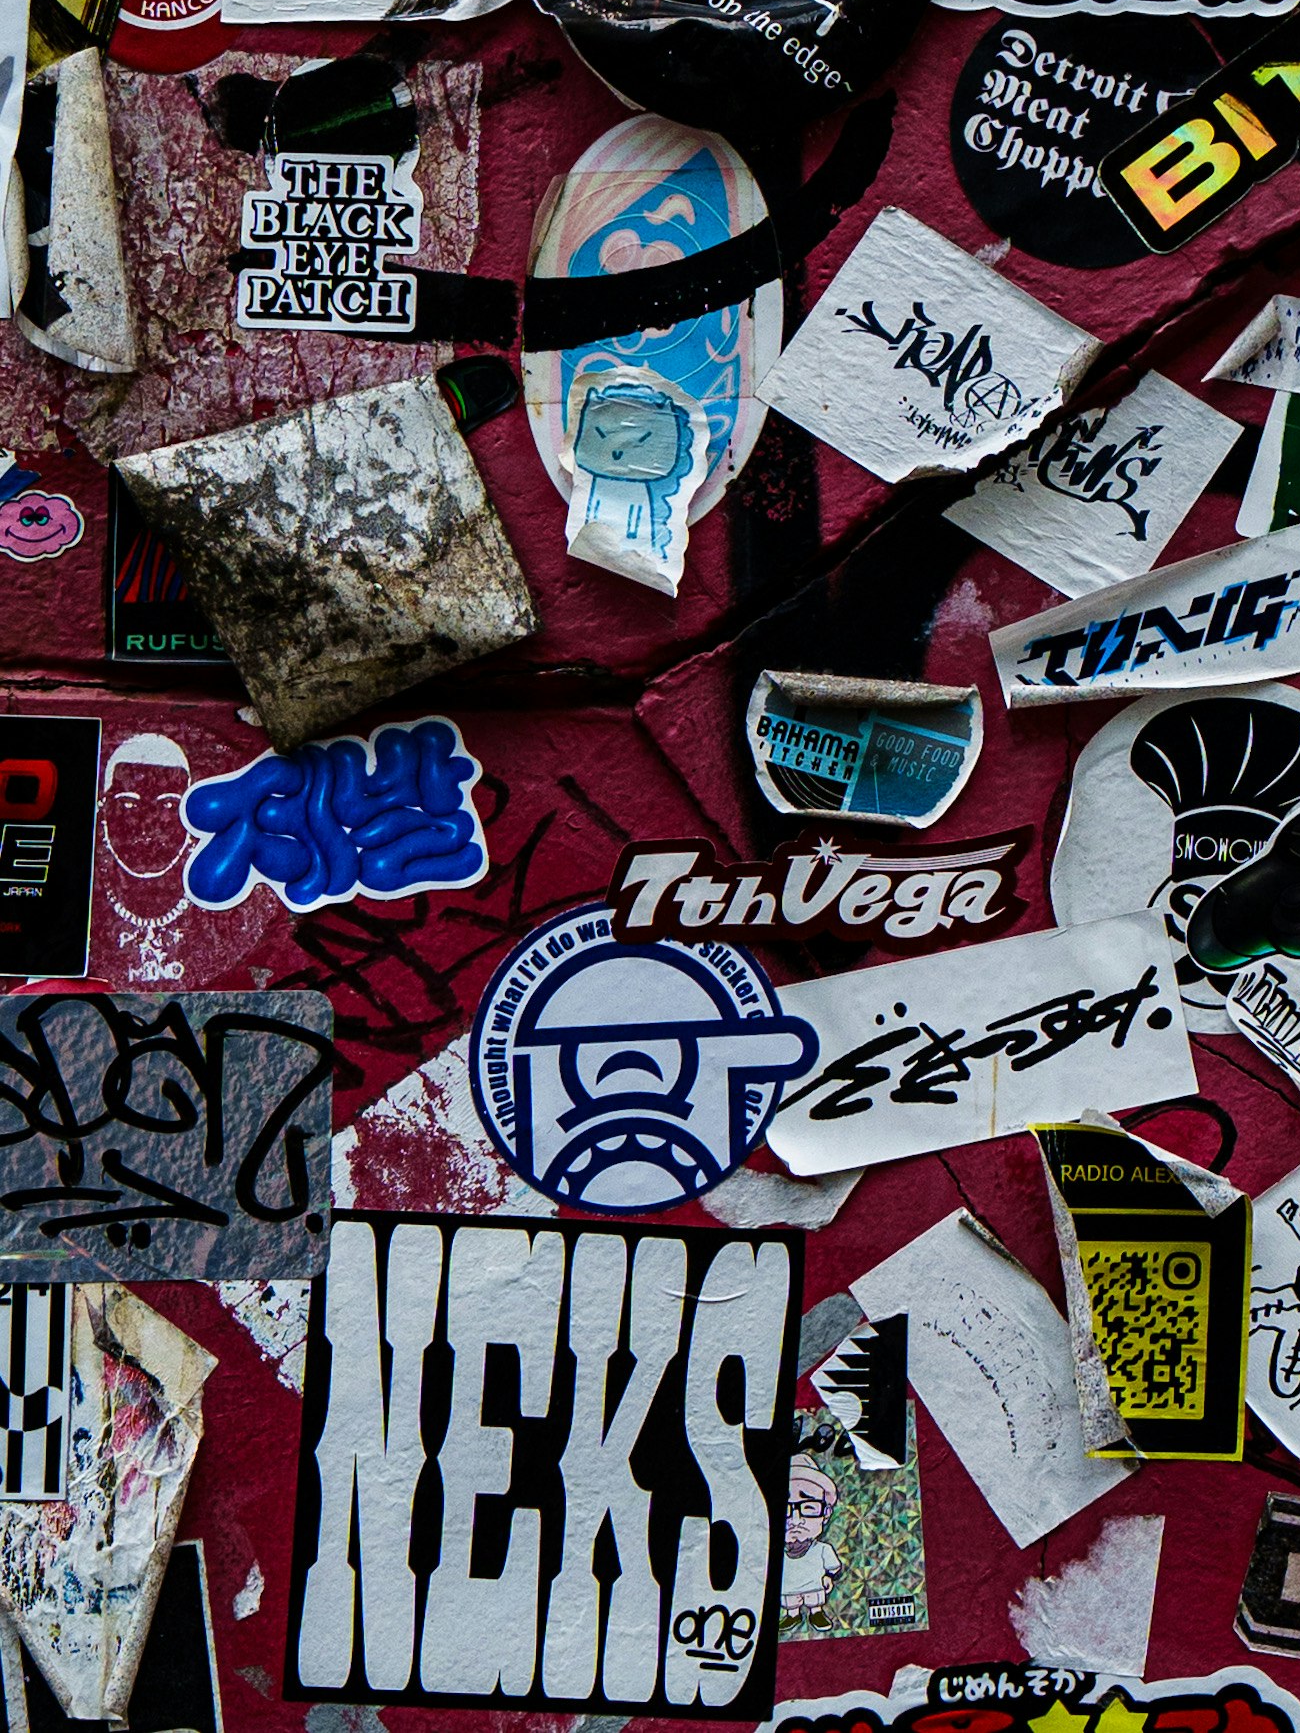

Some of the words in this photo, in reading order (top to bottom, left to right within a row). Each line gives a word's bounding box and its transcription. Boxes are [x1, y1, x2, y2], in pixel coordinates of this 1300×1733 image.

[981, 72, 1092, 141] Meat
[280, 161, 383, 201] THE
[250, 200, 415, 243] BLACK
[284, 240, 374, 280] EYE
[244, 278, 411, 321] PATCH
[756, 715, 861, 765] BAHAMA
[875, 730, 915, 752] GOOD
[919, 741, 961, 769] FOOD
[1060, 1164, 1123, 1185] RADIO
[296, 1220, 792, 1712] NEKS
